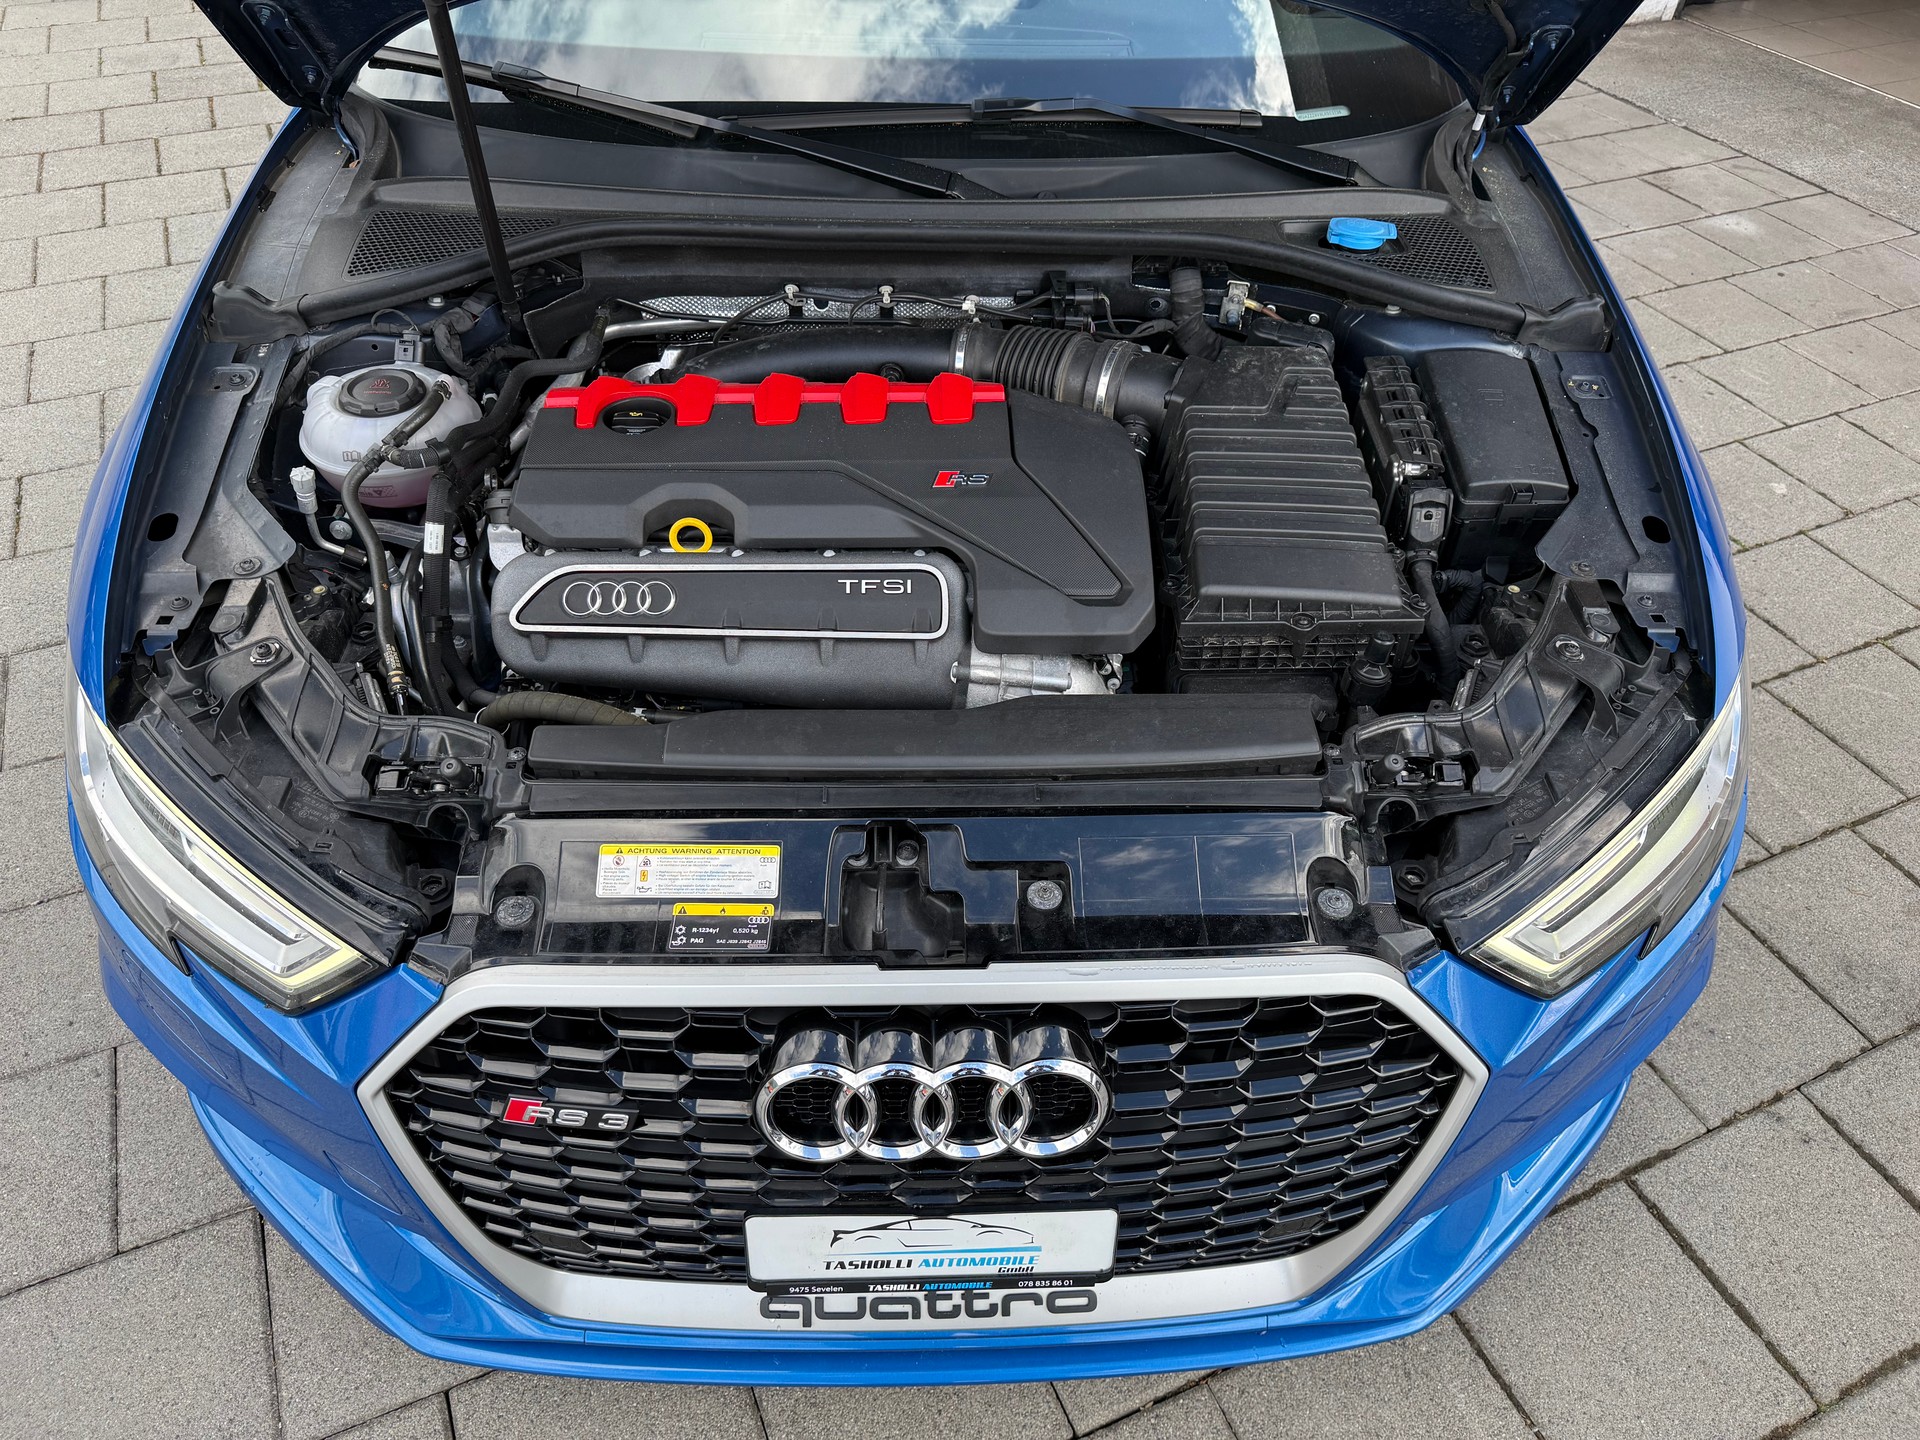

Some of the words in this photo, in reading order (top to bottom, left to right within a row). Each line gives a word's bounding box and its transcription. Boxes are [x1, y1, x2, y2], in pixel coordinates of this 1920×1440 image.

[942, 473, 990, 485] RS
[837, 579, 912, 594] TFSI
[627, 847, 667, 855] ACHTUNG
[750, 927, 759, 935] kg
[519, 1105, 588, 1127] RS
[598, 1113, 629, 1131] 3
[823, 1259, 913, 1270] TASHOLLI
[917, 1255, 1040, 1268] AUTOMOBILE
[997, 1266, 1035, 1274] GmbH
[868, 1284, 920, 1292] TASHOLLI
[922, 1281, 993, 1291] AUTOMOBILE
[1035, 1280, 1050, 1288] 835
[760, 1290, 1098, 1328] quattro
